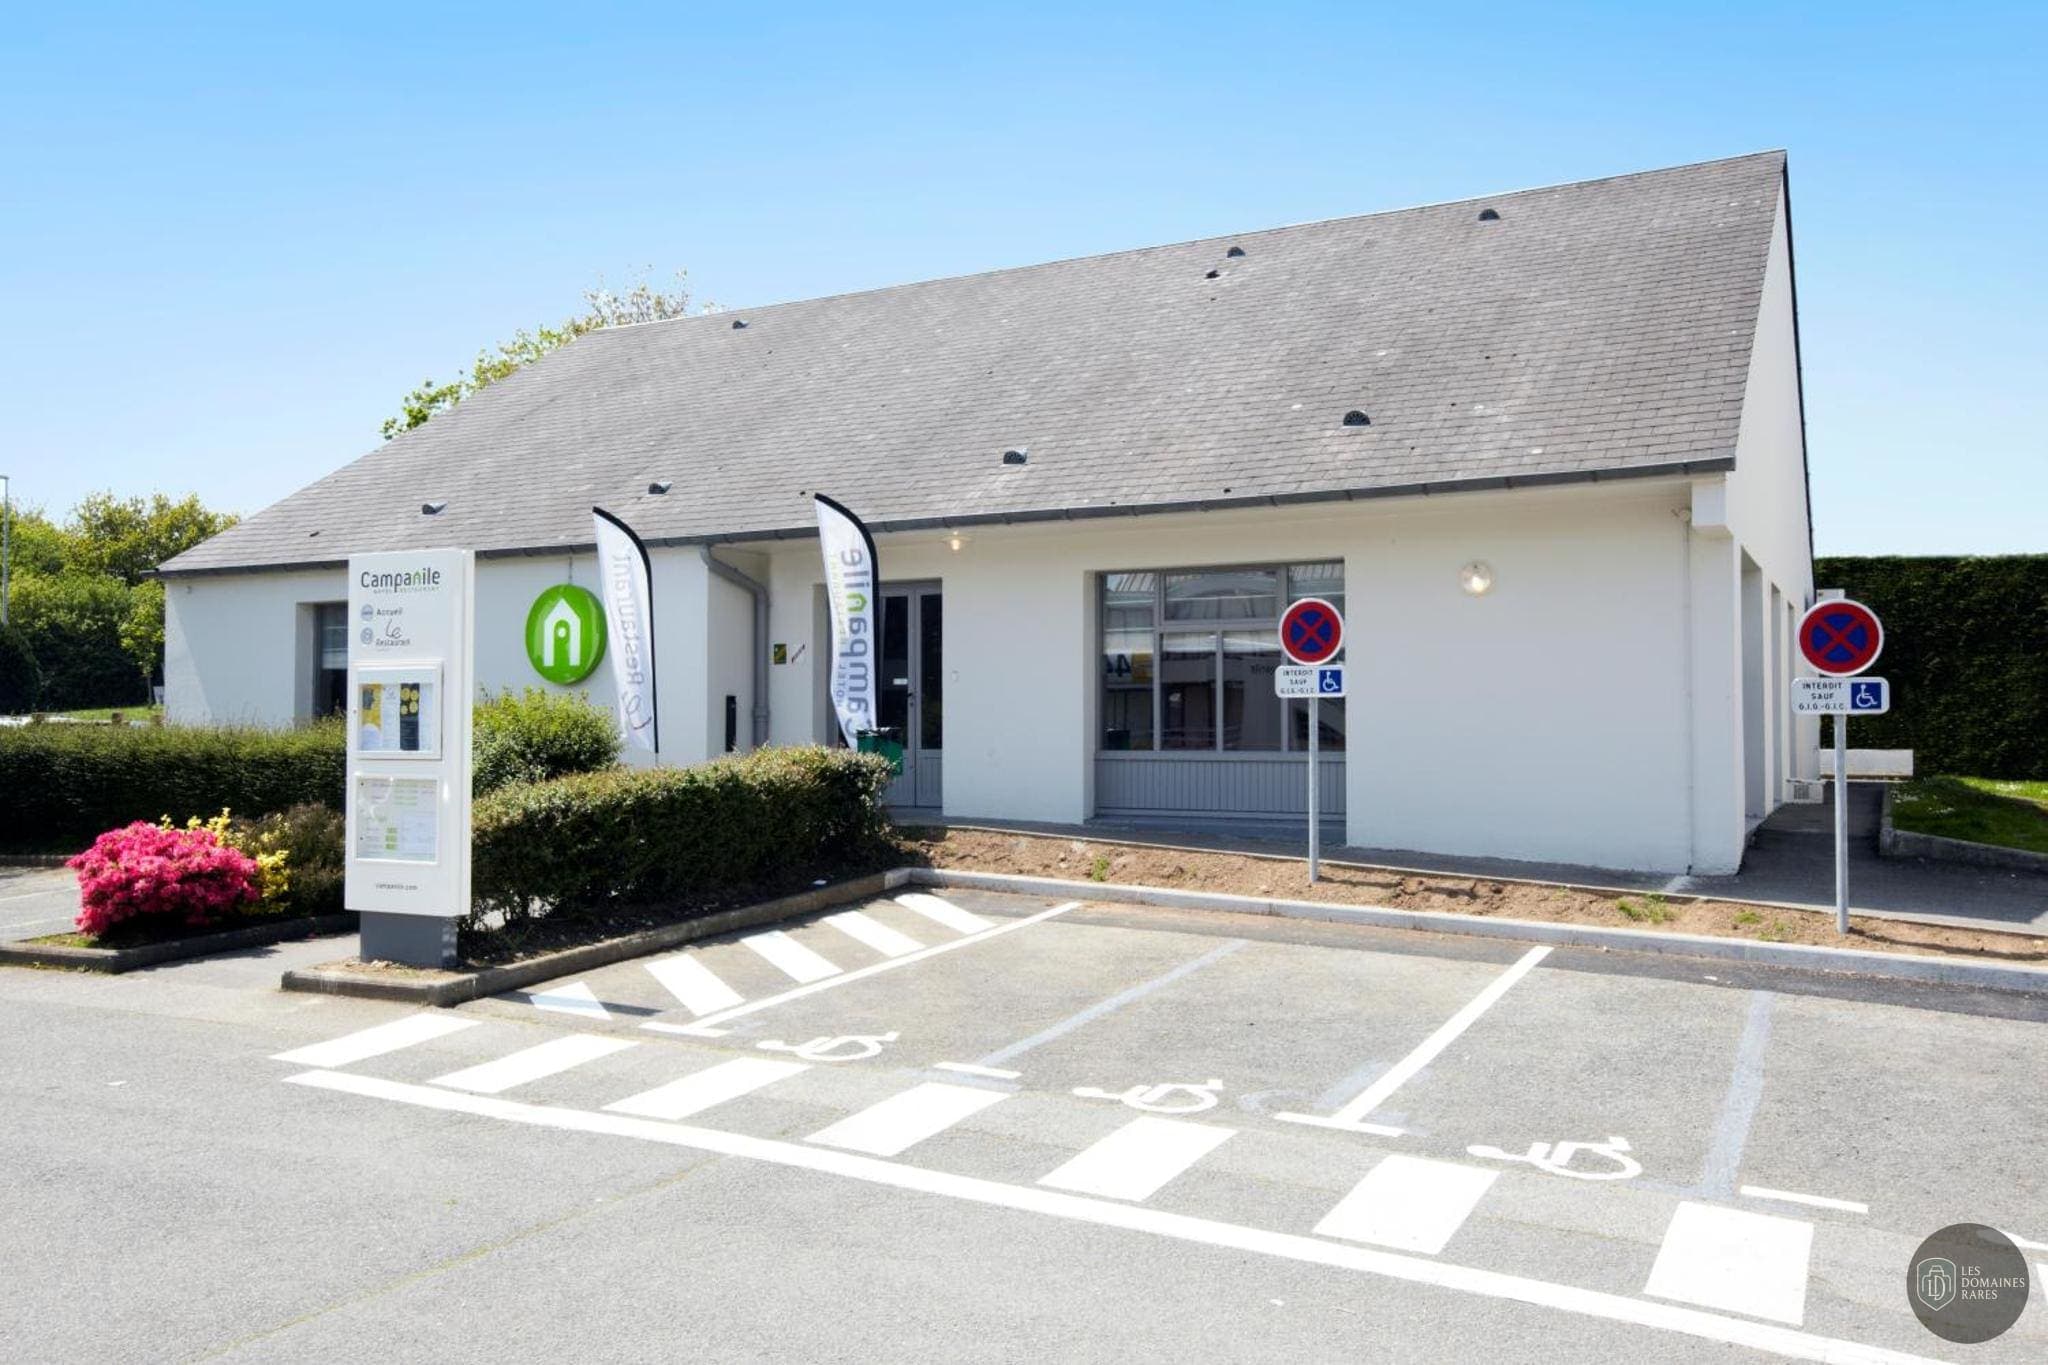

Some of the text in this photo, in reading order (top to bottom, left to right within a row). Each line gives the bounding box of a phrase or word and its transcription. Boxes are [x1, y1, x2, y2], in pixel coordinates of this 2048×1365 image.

[361, 567, 441, 593] Campanile
[376, 606, 403, 617] Accueil
[1282, 669, 1313, 677] INTERDIT
[1802, 682, 1843, 690] INTERDIT
[1811, 692, 1835, 700] SAUF
